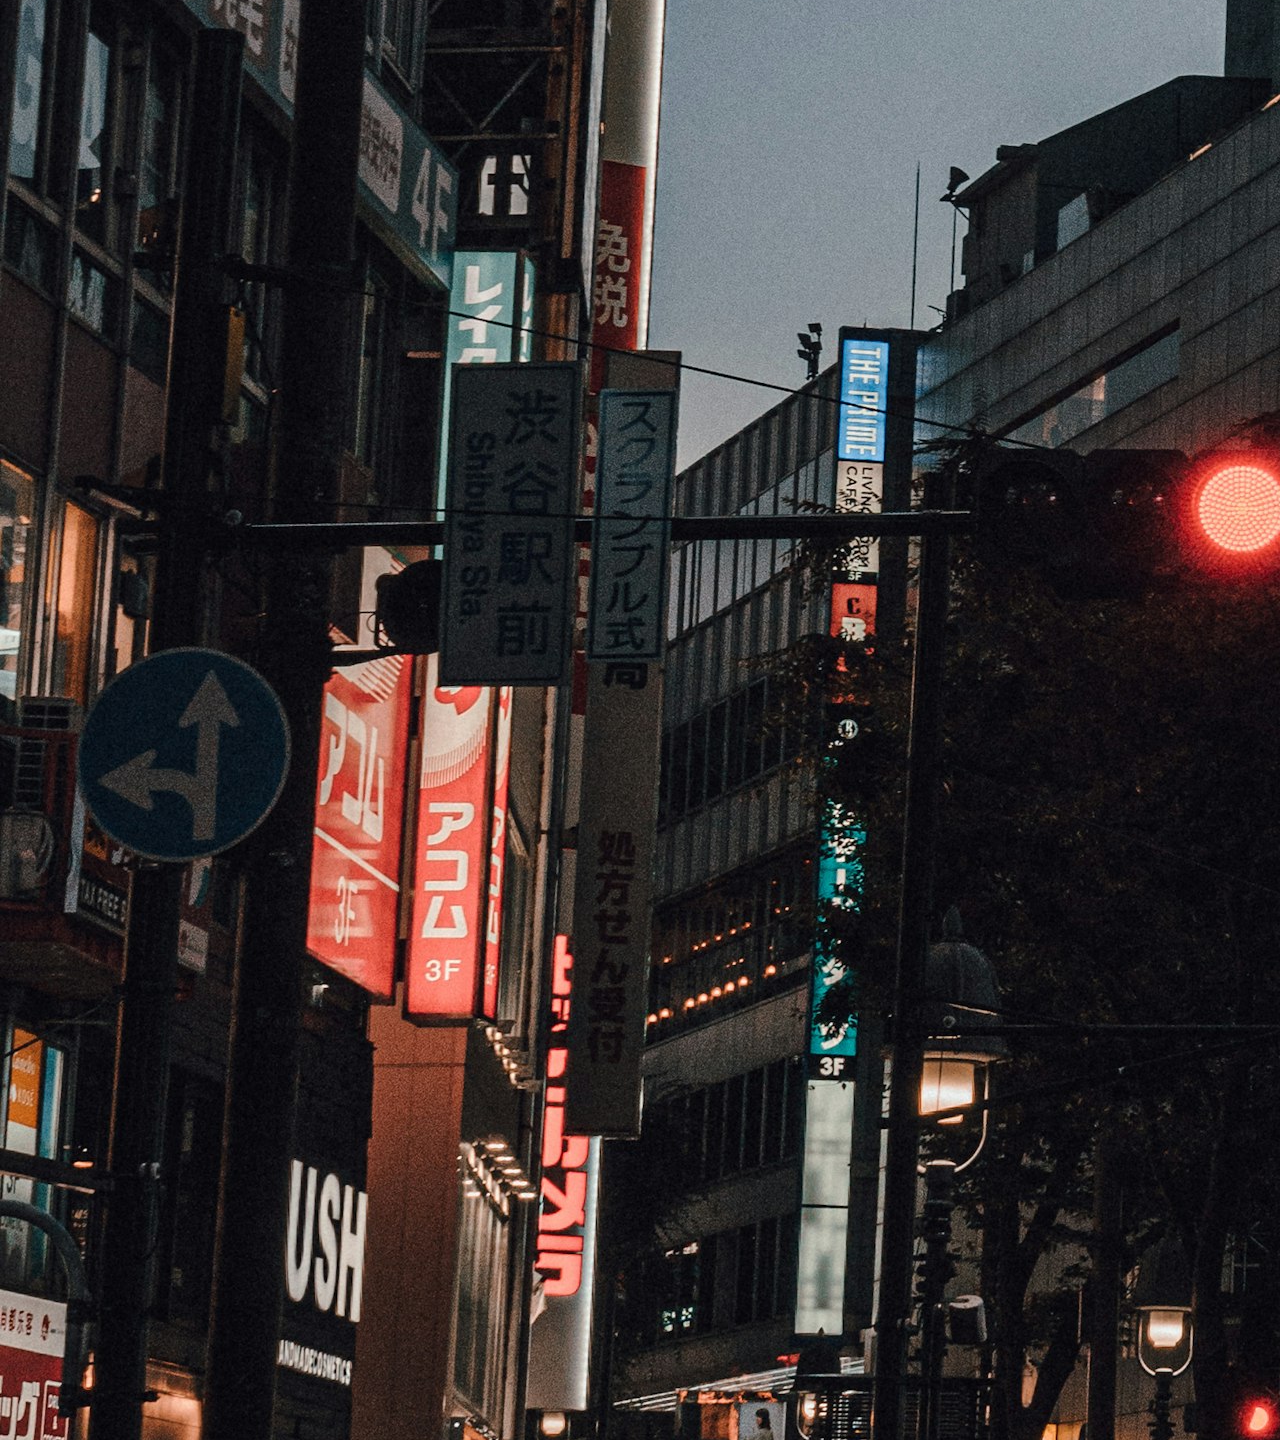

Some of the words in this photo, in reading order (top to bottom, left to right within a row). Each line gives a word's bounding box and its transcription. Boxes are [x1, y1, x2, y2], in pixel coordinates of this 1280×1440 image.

[411, 147, 453, 261] 4F
[597, 218, 632, 329] 免税
[848, 346, 883, 385] THE
[844, 389, 881, 457] PRIME
[462, 430, 498, 554] Shibuya
[497, 389, 559, 659] 渋谷駅前
[605, 399, 657, 653] スクランブル式
[319, 691, 384, 844] アコム
[421, 802, 475, 939] アコム
[424, 959, 462, 982] 3F
[819, 1058, 845, 1077] 3F
